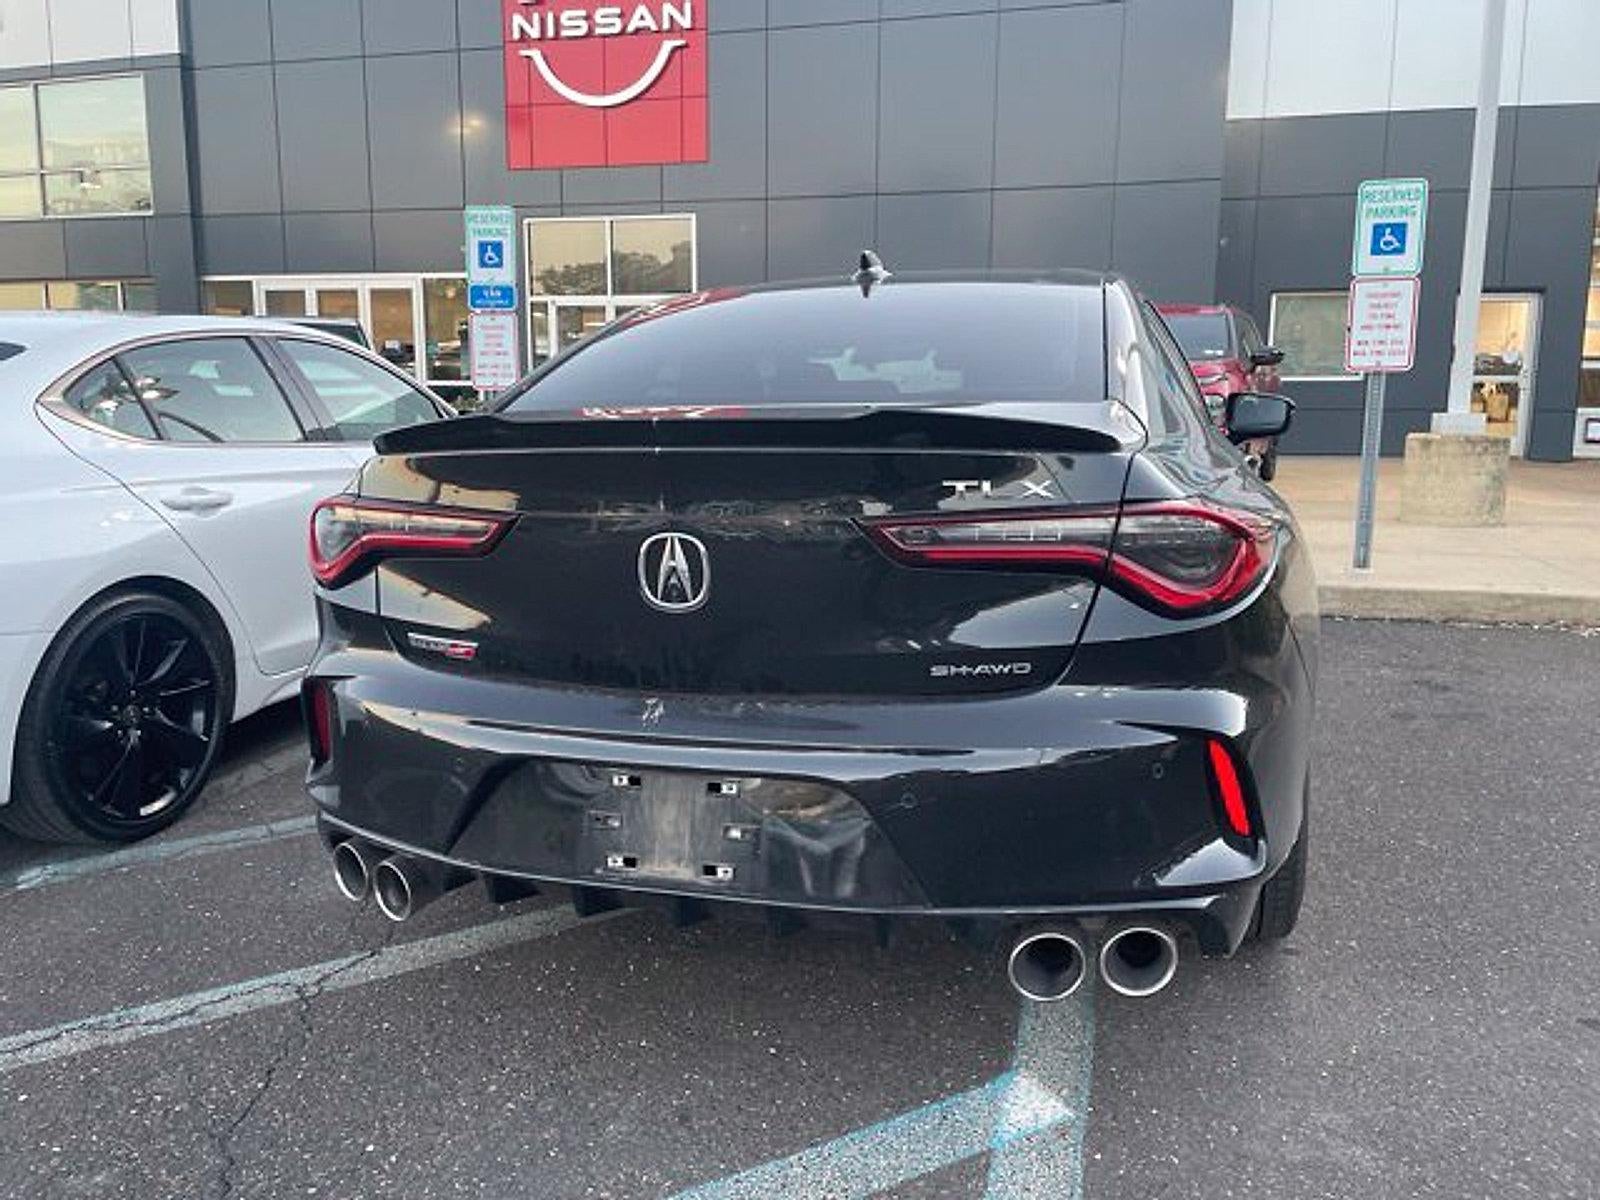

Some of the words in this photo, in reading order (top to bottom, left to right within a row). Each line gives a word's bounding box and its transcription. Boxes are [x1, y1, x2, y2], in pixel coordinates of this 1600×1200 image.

[511, 1, 692, 41] NISSAN
[1362, 187, 1422, 203] RESERVED
[1365, 204, 1417, 219] PARKING
